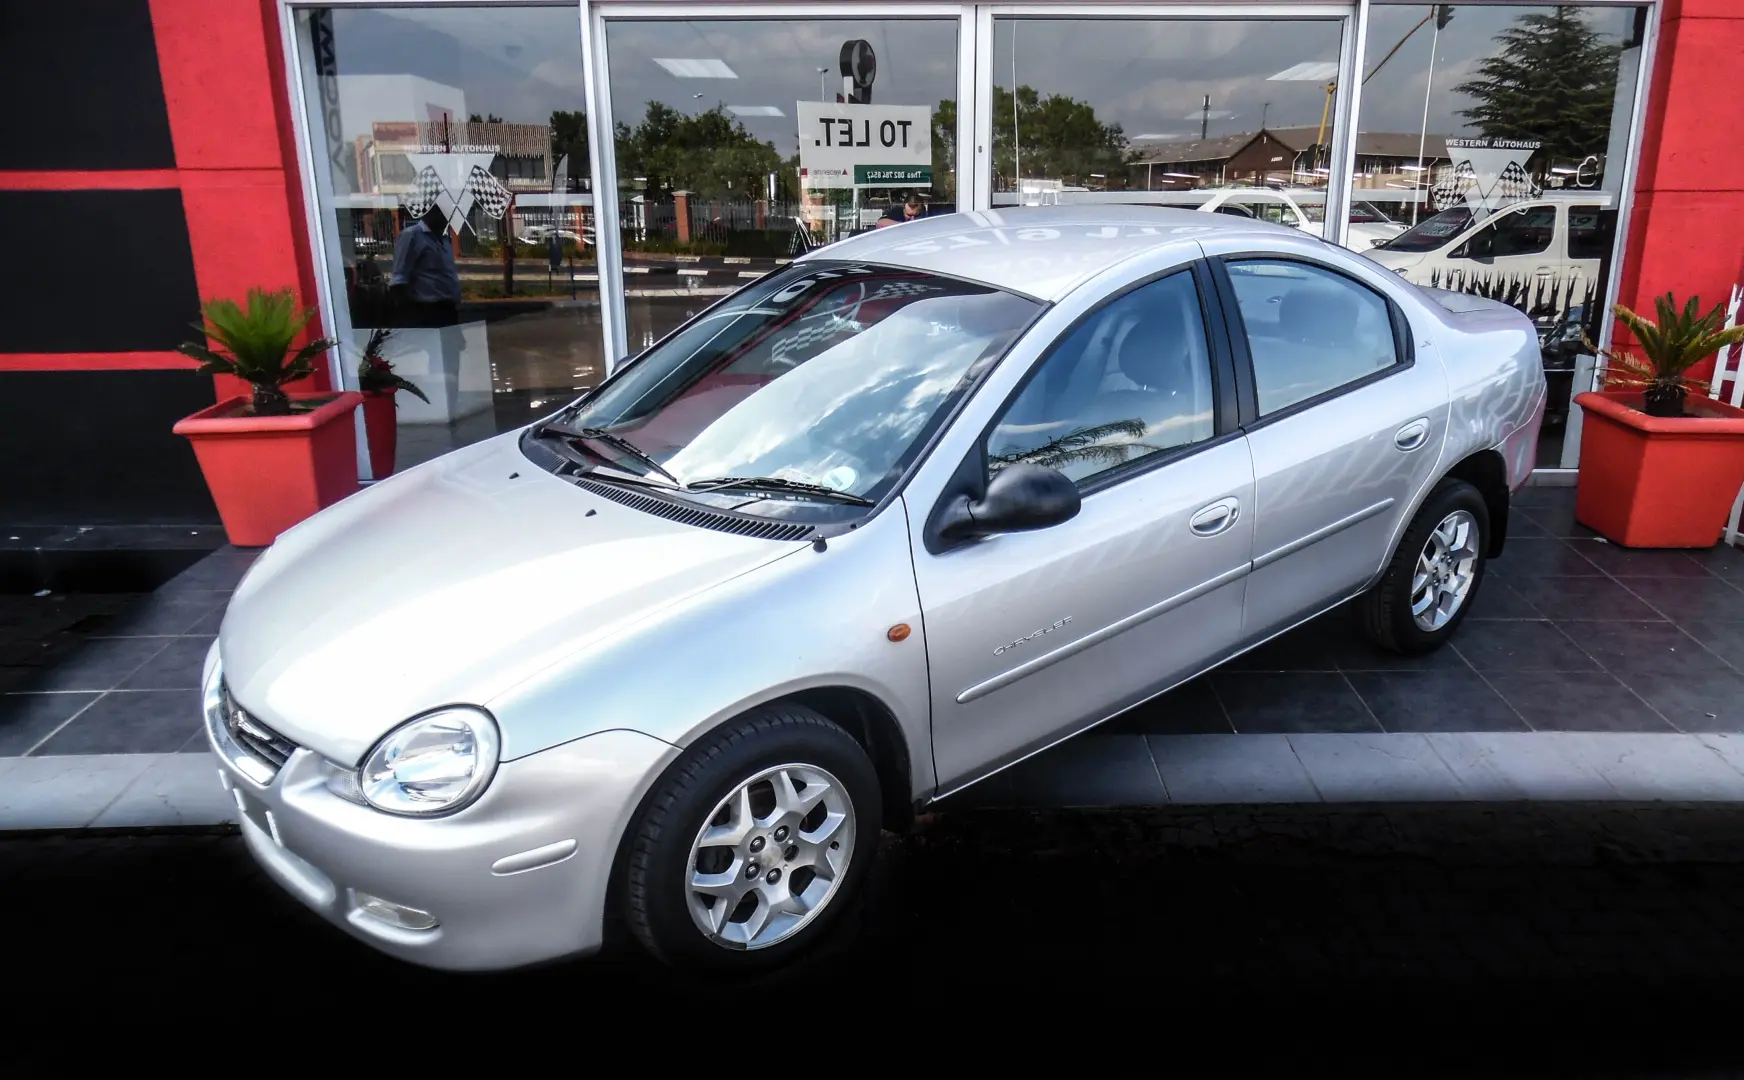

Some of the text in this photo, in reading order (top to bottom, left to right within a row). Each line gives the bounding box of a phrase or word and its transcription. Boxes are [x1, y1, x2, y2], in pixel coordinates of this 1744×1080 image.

[451, 144, 501, 153] AUTOHAUS
[1445, 138, 1541, 149] WESTERN AUTOHAUS
[992, 615, 1073, 657] CHRYSLER
